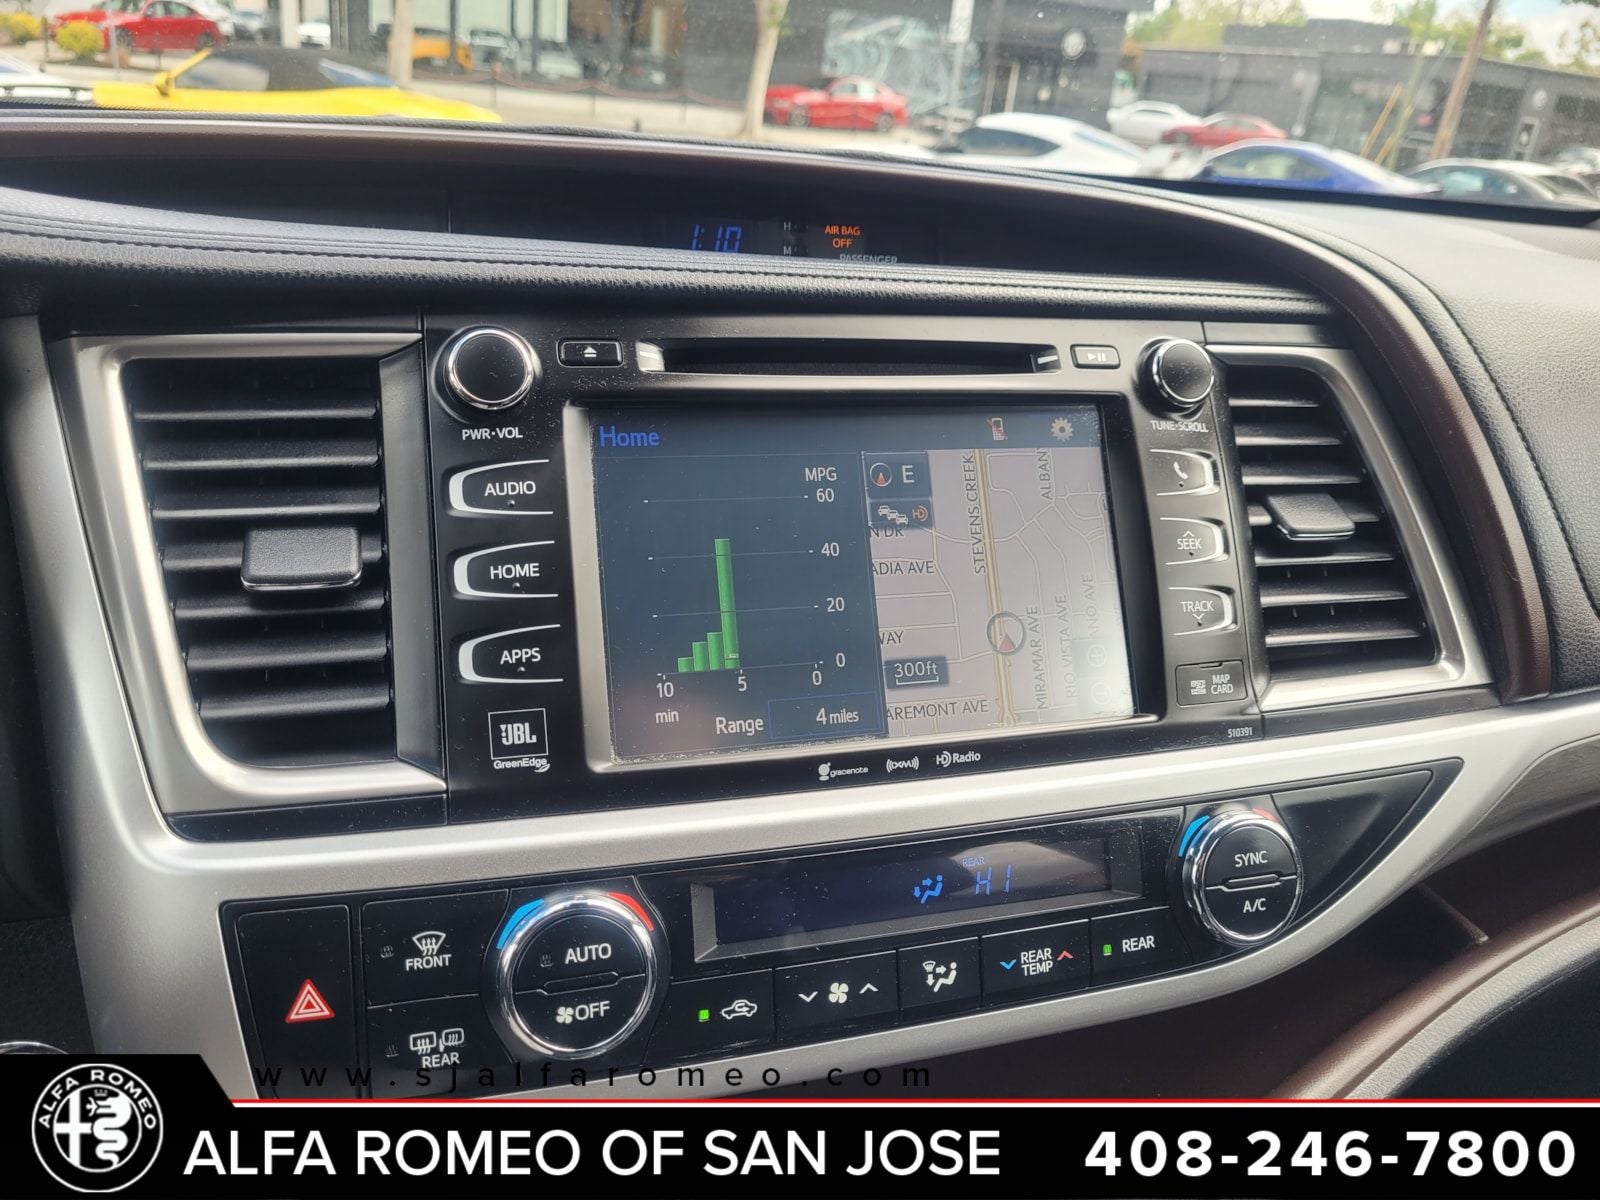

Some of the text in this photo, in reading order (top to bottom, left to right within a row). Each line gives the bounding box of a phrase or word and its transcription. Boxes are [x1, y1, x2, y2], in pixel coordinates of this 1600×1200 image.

[783, 222, 792, 231] H
[824, 225, 861, 236] AIR BAG
[691, 224, 742, 253] 1:10
[832, 238, 853, 248] OFF
[783, 245, 792, 255] M
[839, 253, 898, 264] PASSENGER
[600, 426, 660, 447] Home
[805, 467, 837, 482] MPG
[902, 465, 915, 483] E
[1036, 447, 1053, 501] ALBAN
[484, 480, 537, 497] AUDIO
[816, 487, 835, 503] 60
[962, 452, 987, 575] STEVENS CREEK
[821, 542, 840, 557] 40
[1176, 538, 1202, 550] SEEK
[490, 563, 540, 580] HOME
[907, 560, 935, 574] AVE
[1082, 573, 1096, 599] AVE
[826, 597, 845, 612] 20
[1180, 600, 1215, 613] TRACK
[1055, 594, 1078, 699] RIO VISTA AVE
[500, 648, 541, 664] APPS
[836, 652, 846, 668] 0
[1026, 606, 1049, 710] MIRAMAR AVE
[894, 660, 938, 677] 300ft
[656, 671, 822, 698] 10 5 0
[1212, 674, 1231, 685] MAP
[1211, 684, 1234, 695] CARD
[962, 699, 989, 714] AVE
[655, 708, 679, 725] min
[816, 707, 860, 725] 4 miles
[500, 722, 537, 746] JBL
[715, 716, 764, 736] Range
[1227, 727, 1253, 738] 510391
[493, 757, 548, 770] GreenEdge
[952, 750, 981, 764] Radio
[830, 765, 869, 777] gracenote
[962, 856, 985, 867] REAR
[1234, 850, 1268, 867] SYNC
[1243, 898, 1267, 913] A/C
[1122, 935, 1155, 953] REAR
[565, 943, 612, 964] AUTO
[1020, 947, 1052, 965] REAR
[405, 954, 452, 971] FRONT
[1021, 961, 1053, 977] TEMP
[575, 1001, 611, 1021] OFF
[421, 1052, 460, 1069] REAR
